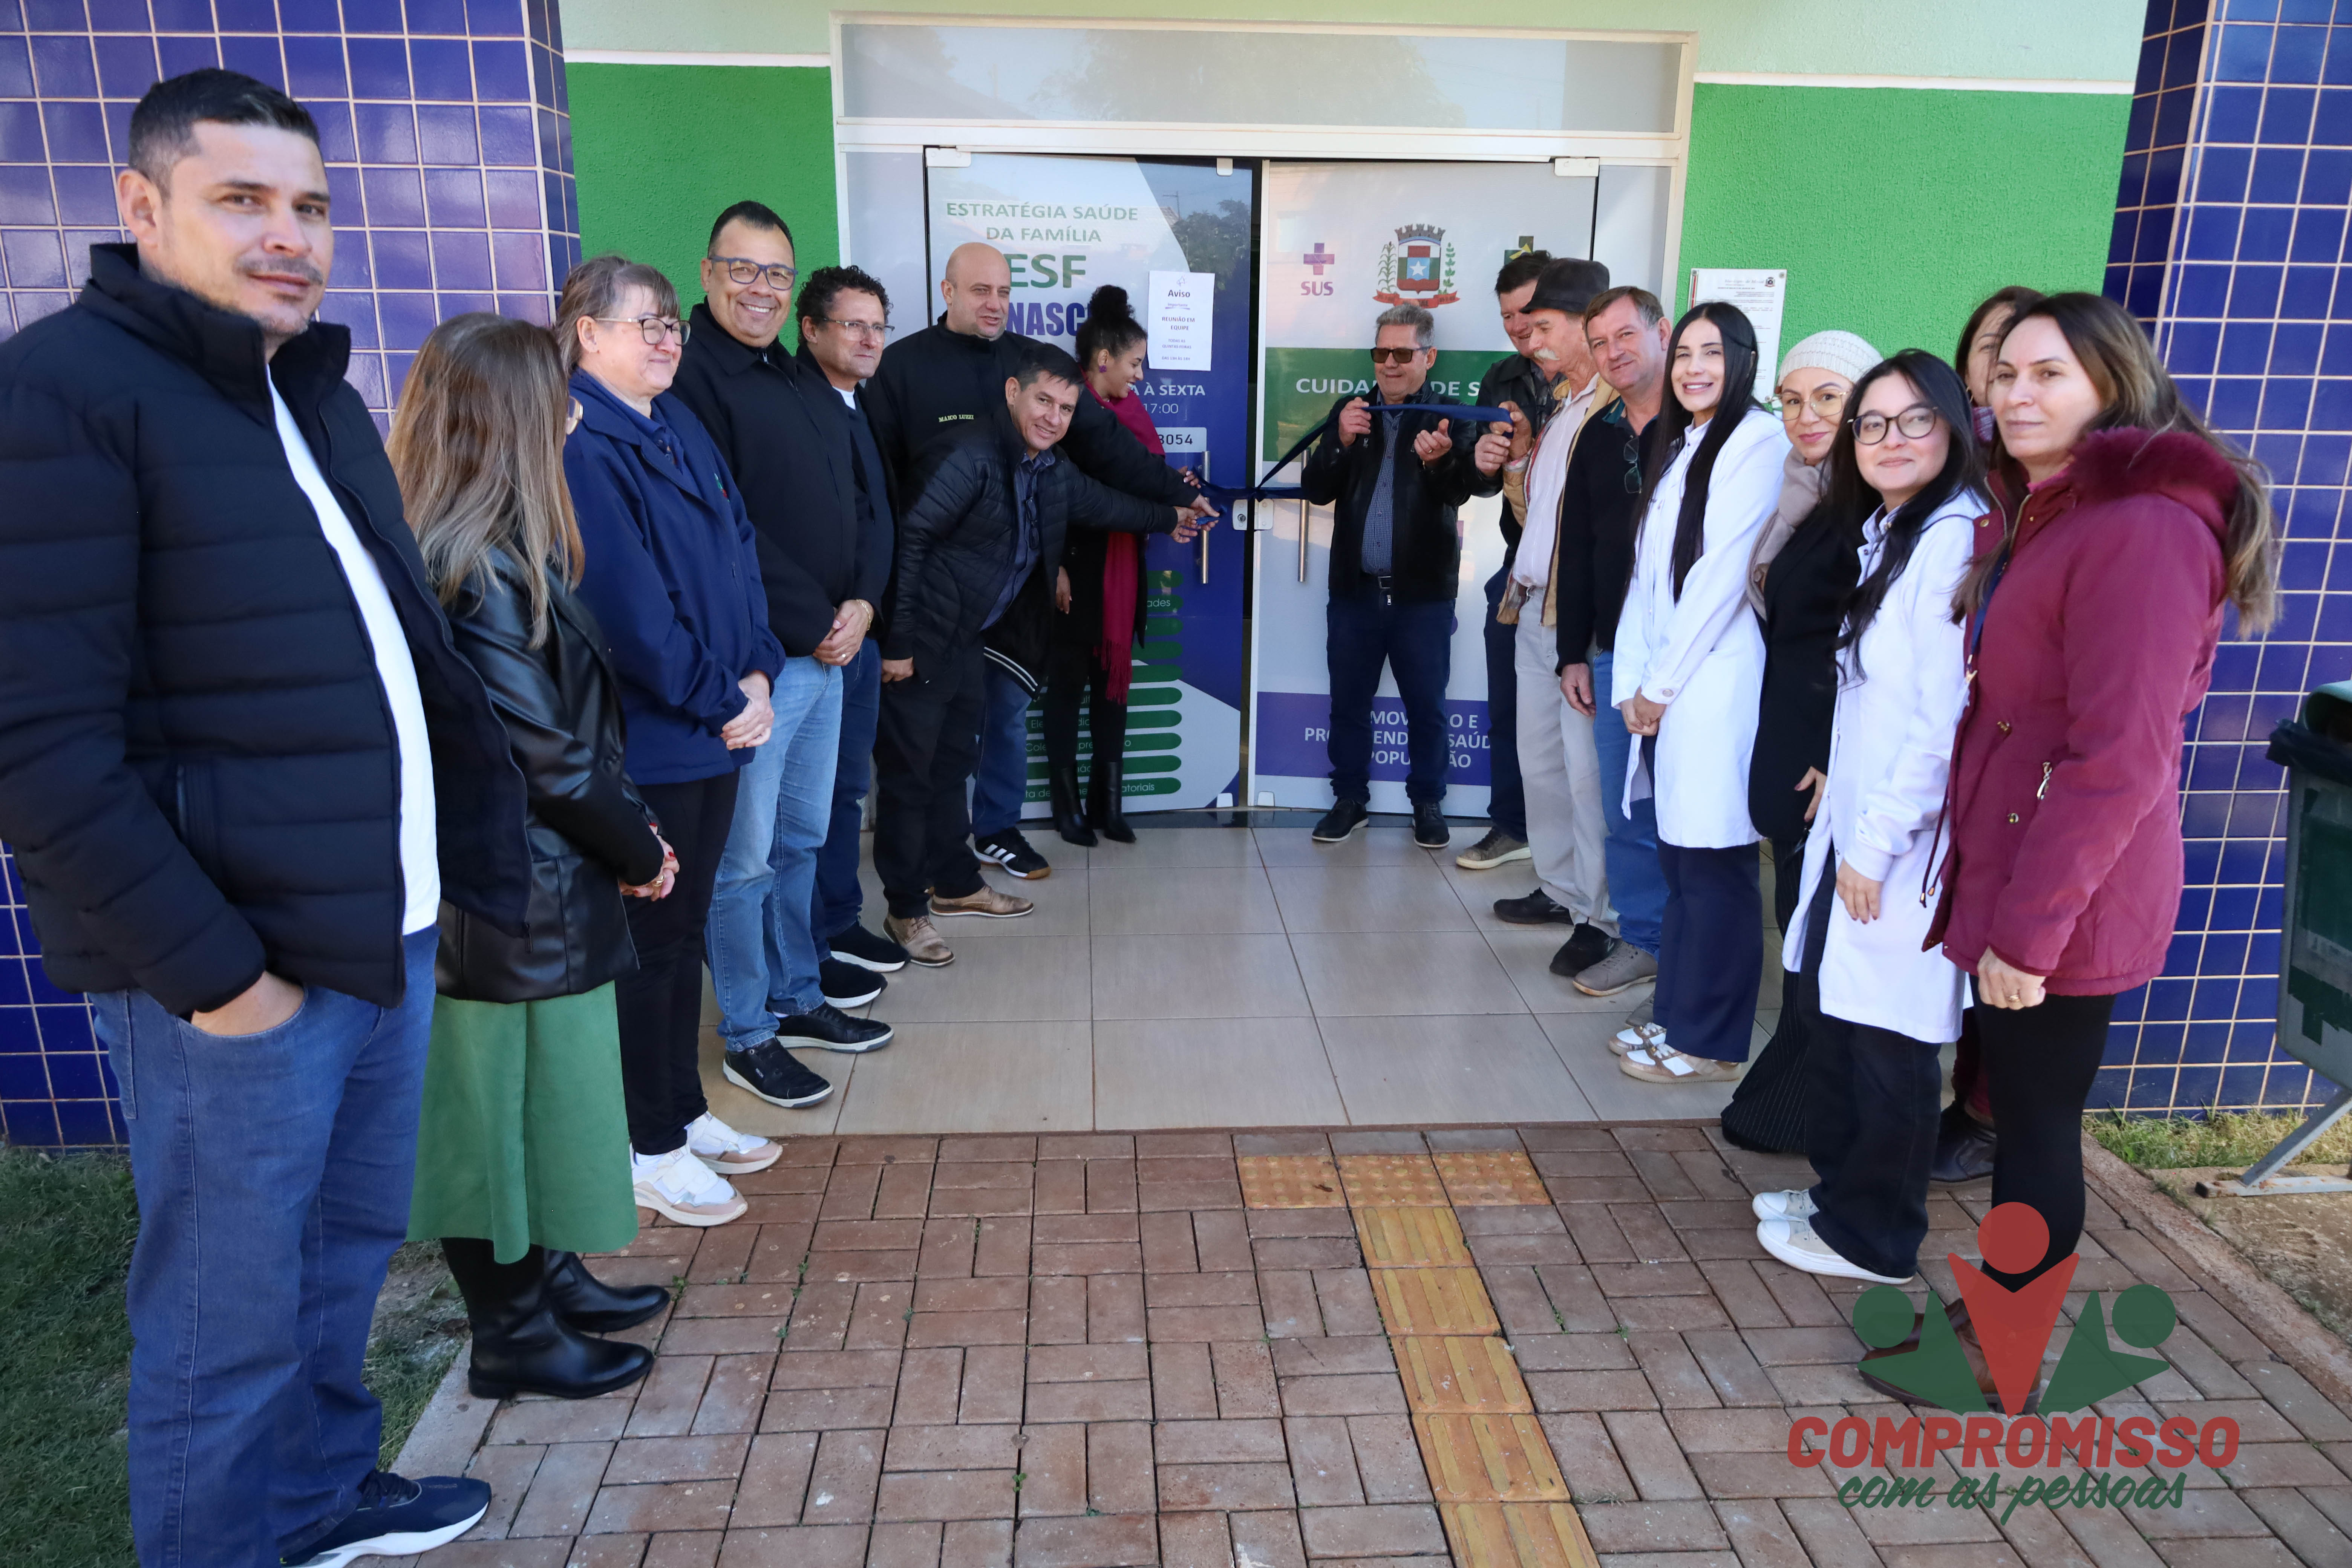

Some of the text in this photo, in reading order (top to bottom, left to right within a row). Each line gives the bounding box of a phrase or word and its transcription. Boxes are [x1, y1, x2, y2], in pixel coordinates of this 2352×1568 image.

[947, 202, 1138, 220] ESTRATÉGIA SAÚDE
[986, 226, 1102, 242] DA FAMÍLIA
[1003, 253, 1087, 288] ESF
[1301, 281, 1334, 296] SUS
[1144, 382, 1155, 395] À
[1159, 385, 1205, 396] SEXTA
[1433, 381, 1460, 396] DE
[1144, 403, 1179, 414] 17:00
[1469, 715, 1478, 728] E
[1449, 731, 1490, 749] SAÚD
